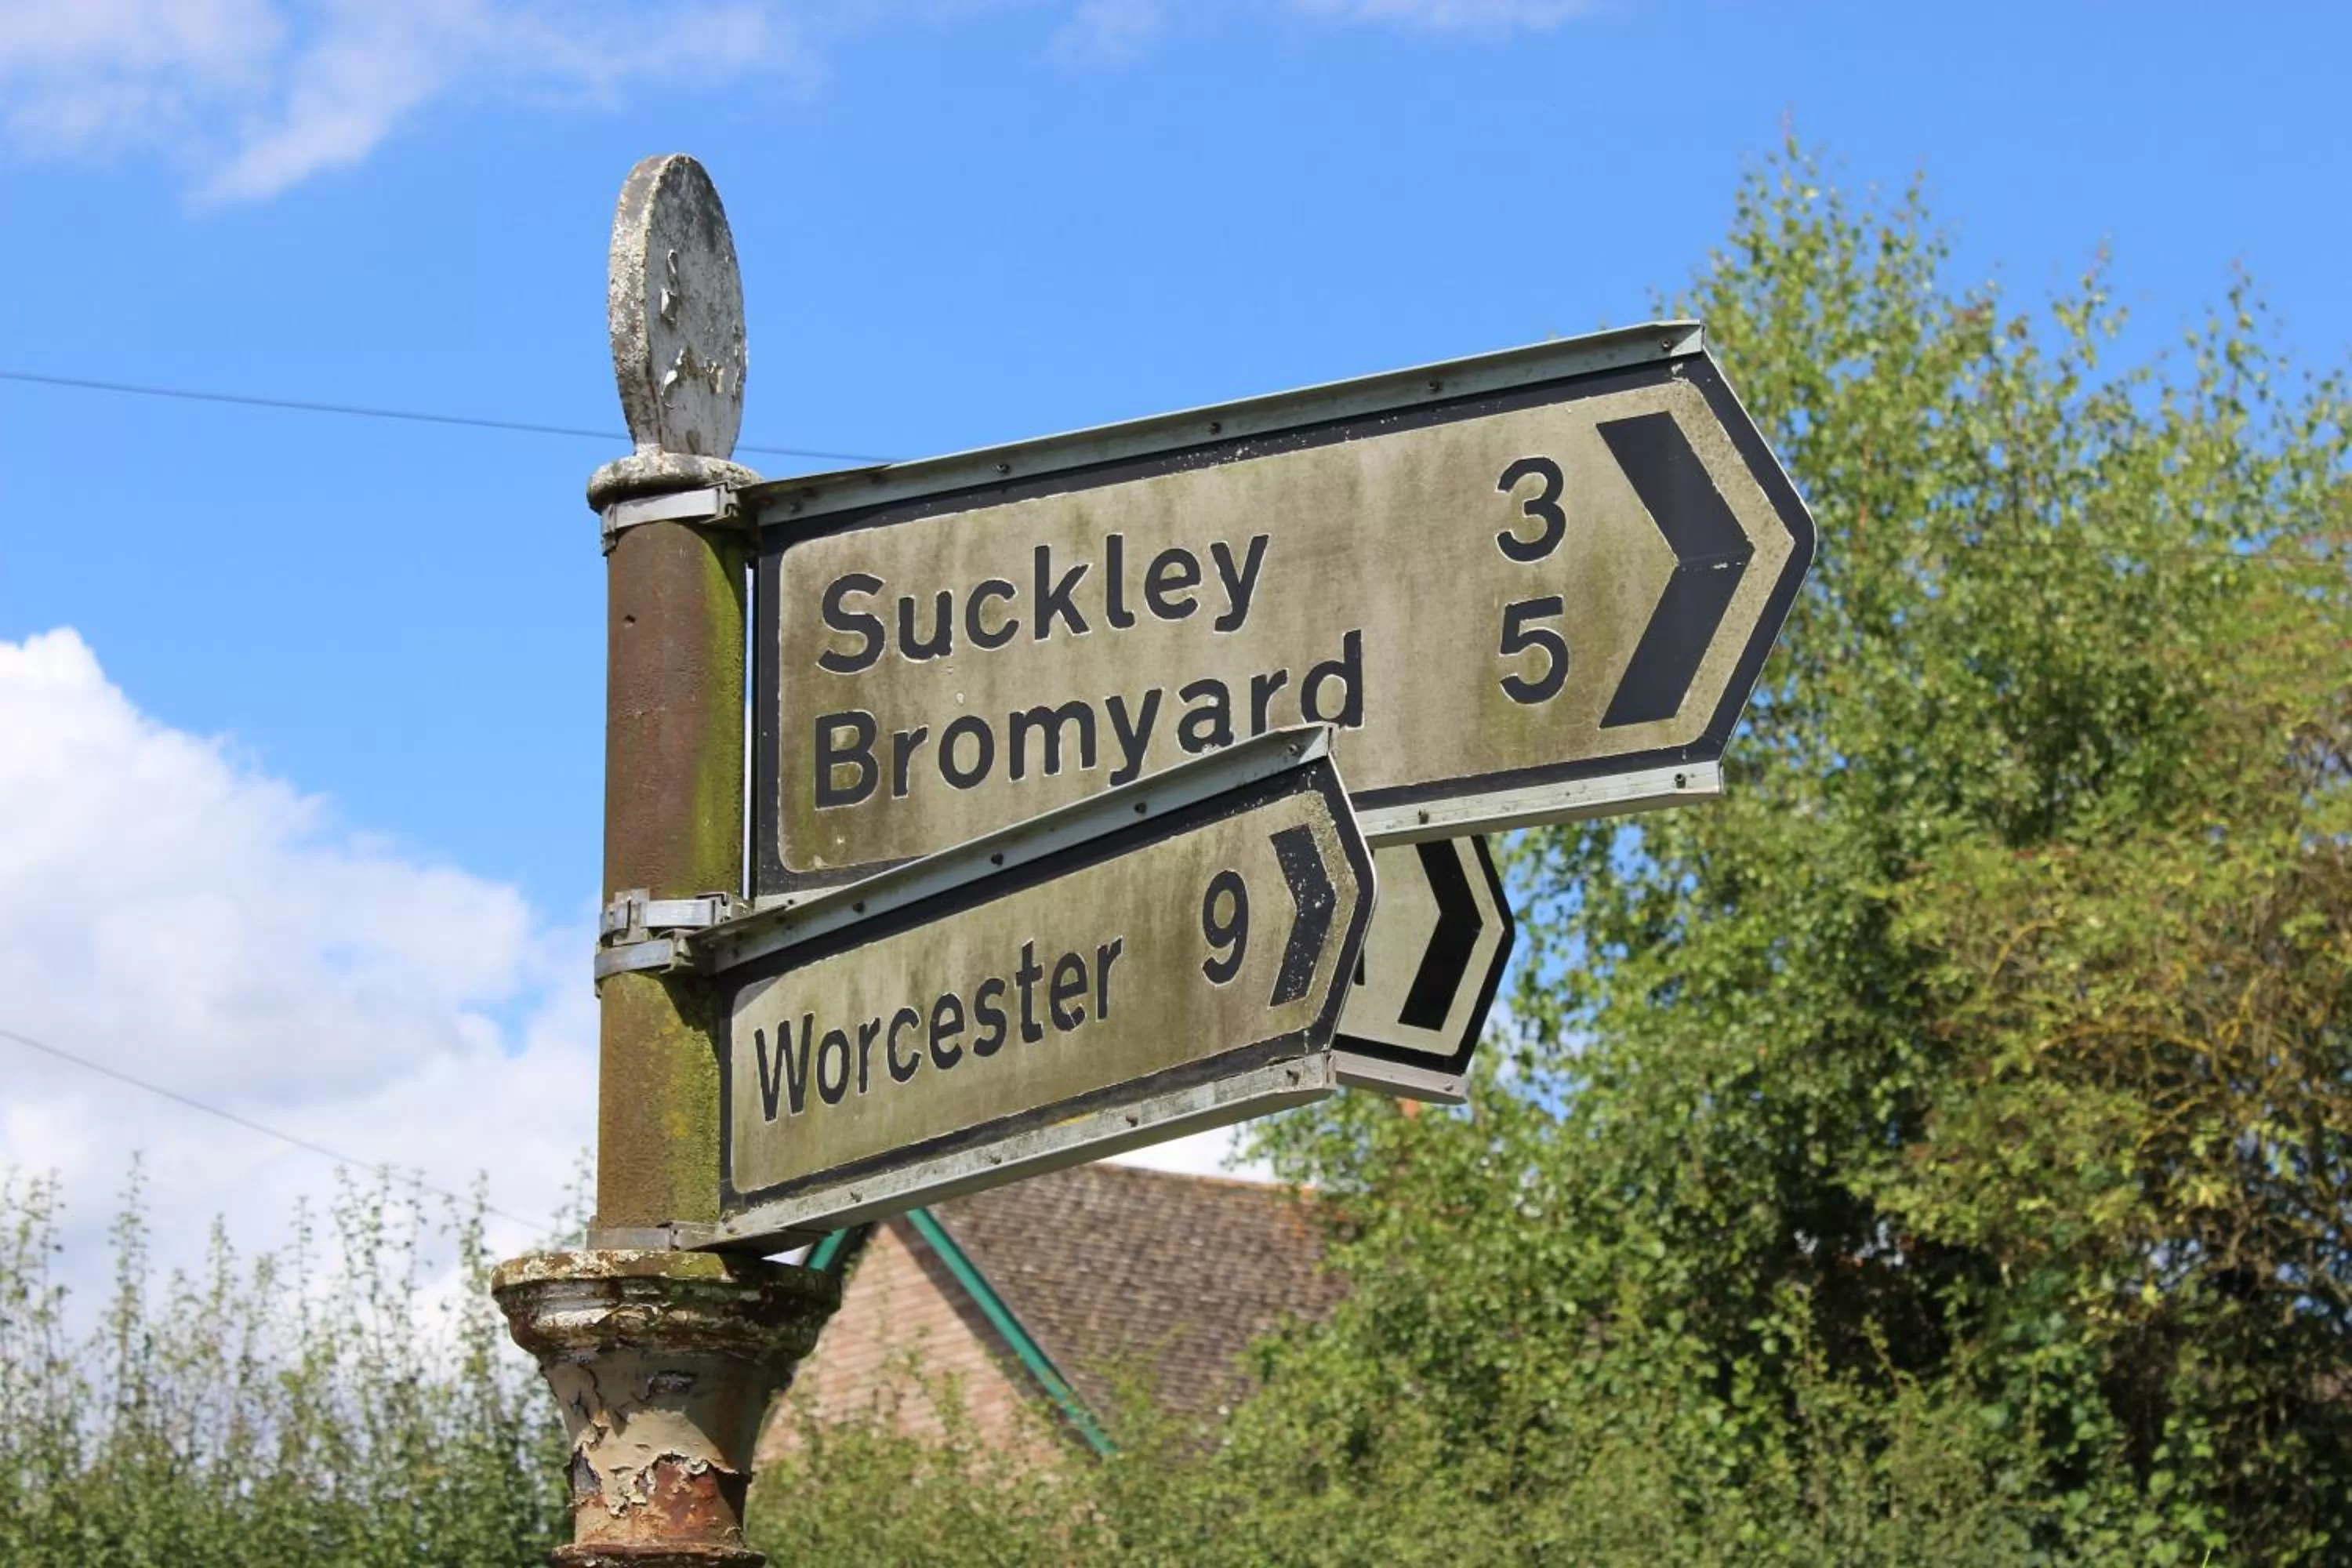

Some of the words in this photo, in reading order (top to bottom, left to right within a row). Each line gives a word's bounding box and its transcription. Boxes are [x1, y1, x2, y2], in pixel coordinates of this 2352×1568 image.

[816, 534, 1269, 673] Suckley
[1496, 456, 1566, 561] 3
[815, 630, 1363, 809] Bromyard
[1500, 595, 1568, 703] 5
[755, 938, 1121, 1121] Worcester
[1203, 869, 1249, 984] 9
